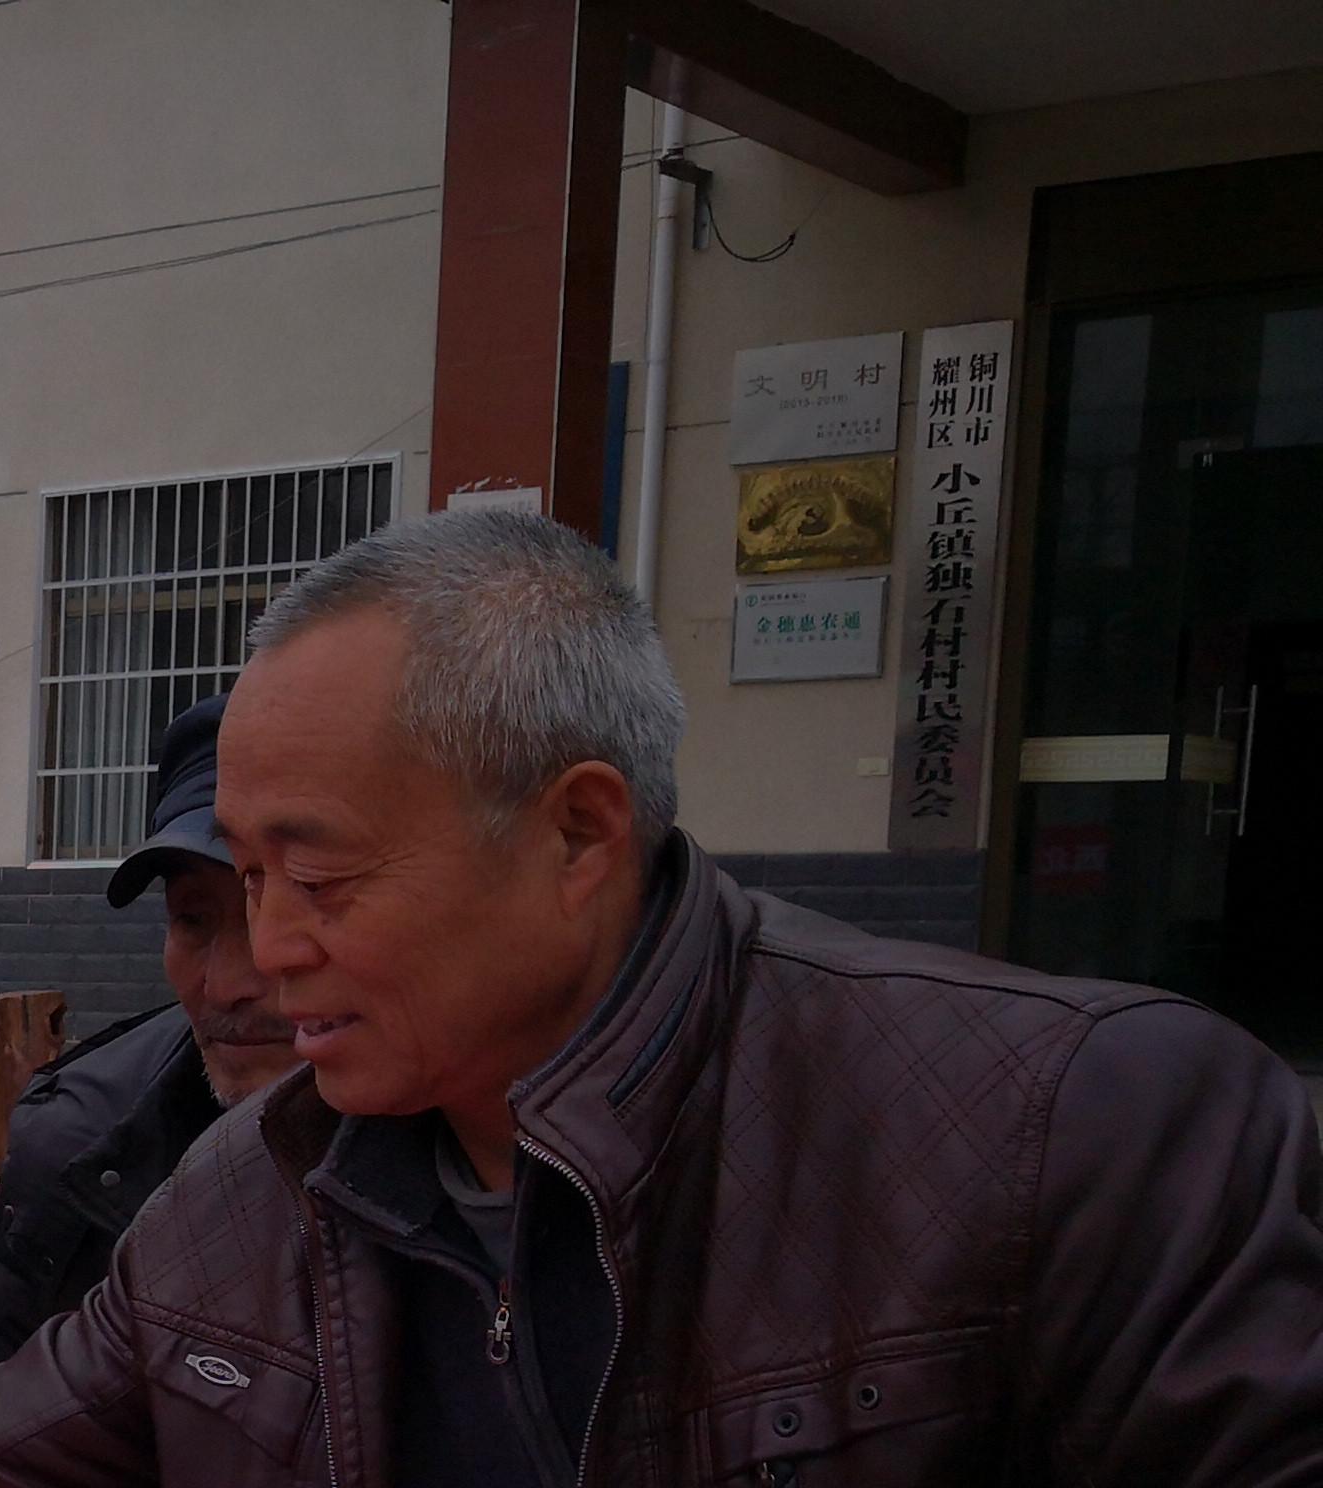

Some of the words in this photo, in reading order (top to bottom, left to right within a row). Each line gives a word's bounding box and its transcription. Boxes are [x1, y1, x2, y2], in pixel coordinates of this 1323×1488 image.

[744, 362, 887, 398] 文明村
[927, 355, 962, 450] 耀州区
[962, 353, 1000, 448] 铜川市
[757, 610, 862, 634] 金穗惠农通
[910, 461, 982, 819] 小丘镇独石村村民委员会
